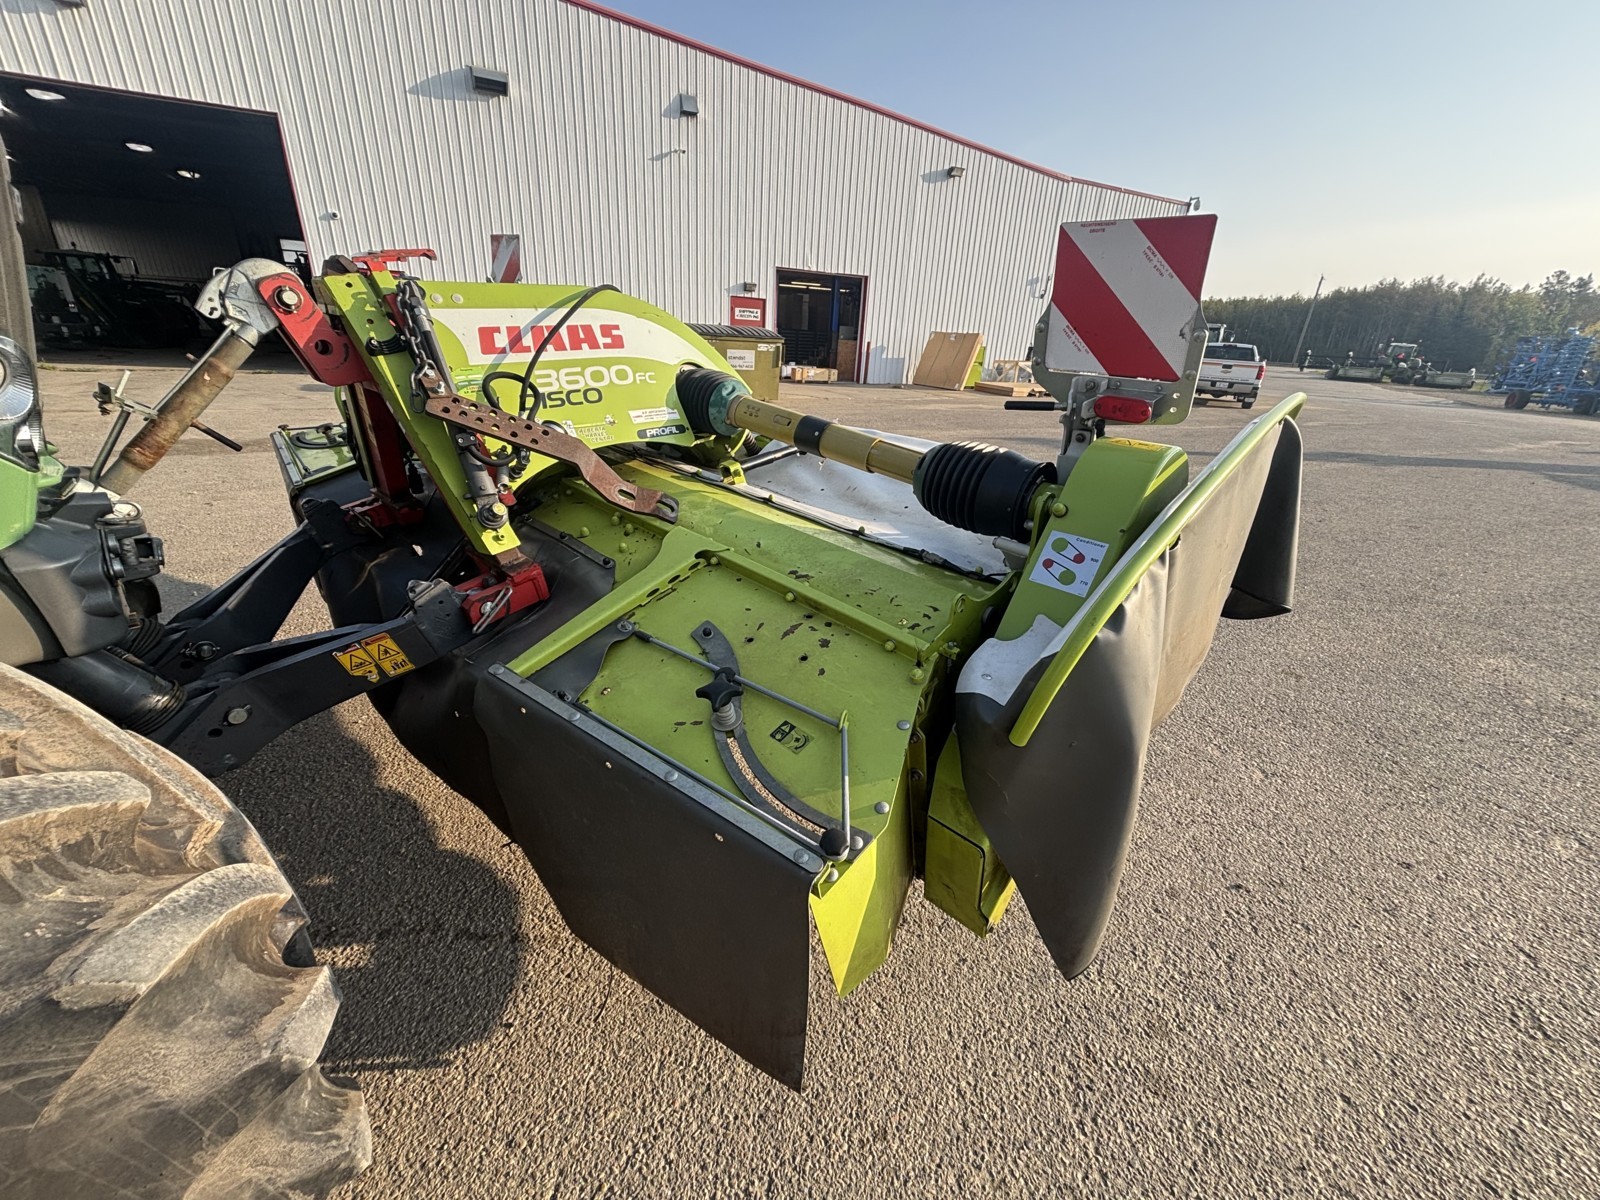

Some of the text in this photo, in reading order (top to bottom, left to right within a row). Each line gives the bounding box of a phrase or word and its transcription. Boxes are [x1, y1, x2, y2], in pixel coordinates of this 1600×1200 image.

[477, 324, 625, 355] CLAAS
[534, 364, 634, 392] 3600
[646, 426, 679, 437] PROFIL
[1076, 537, 1106, 549] Conditioner
